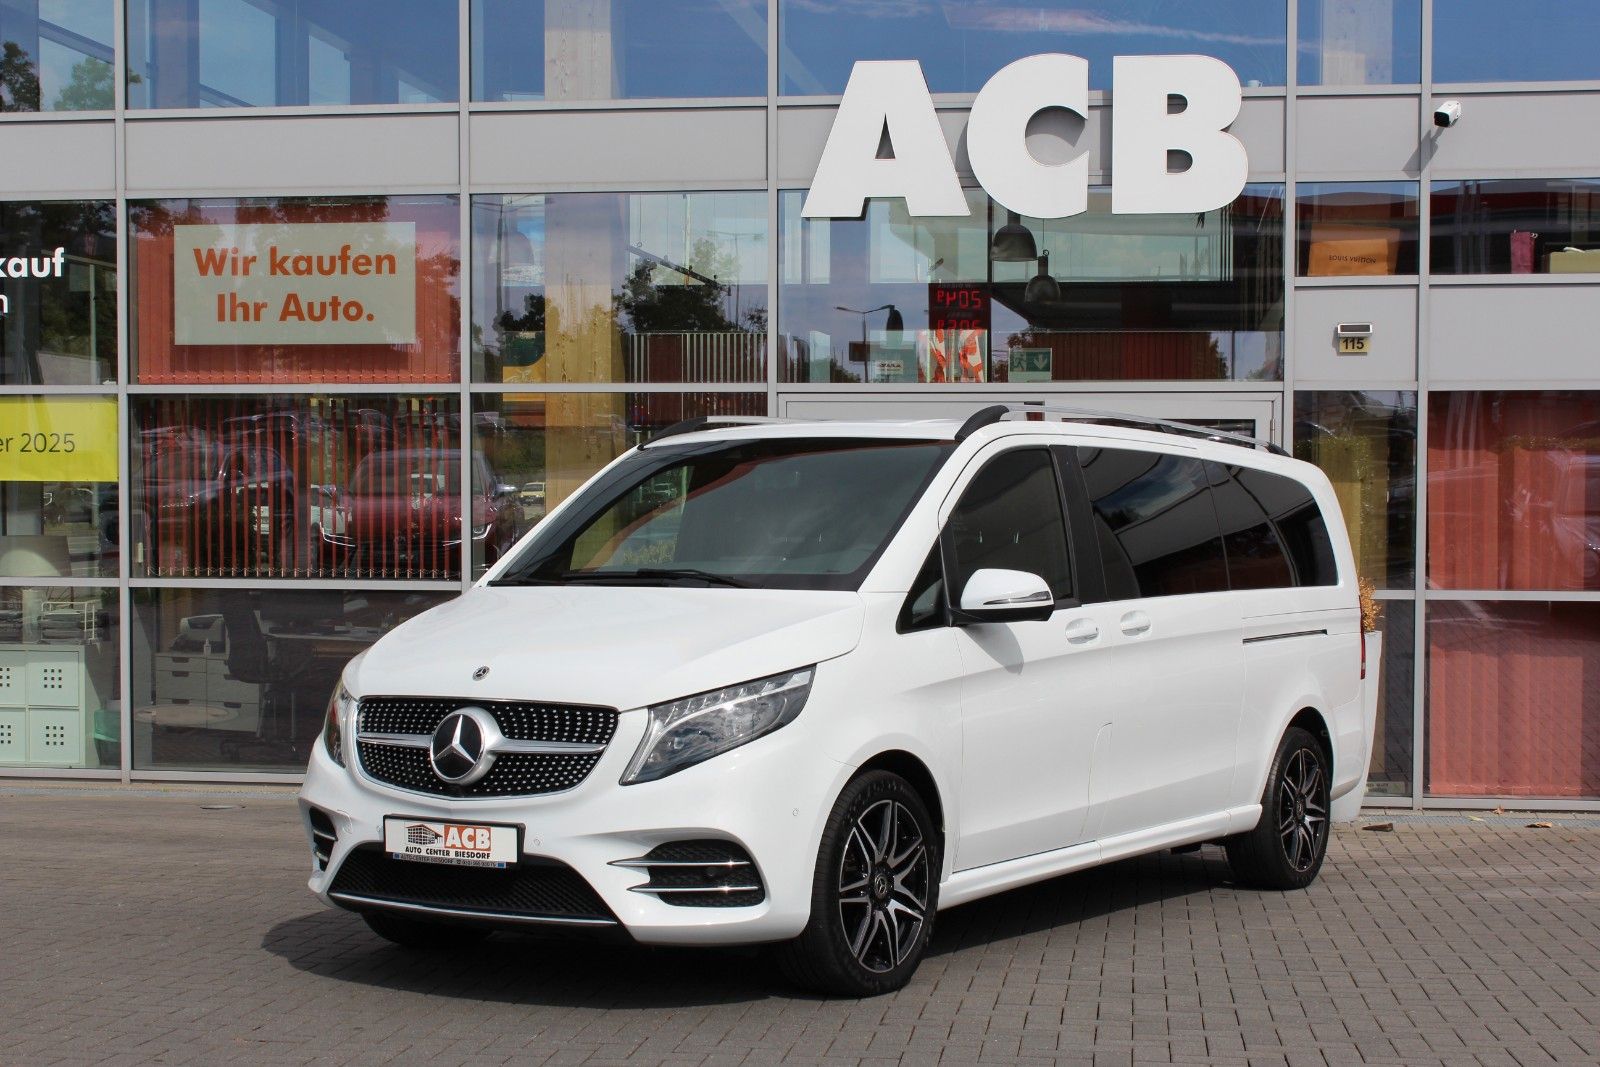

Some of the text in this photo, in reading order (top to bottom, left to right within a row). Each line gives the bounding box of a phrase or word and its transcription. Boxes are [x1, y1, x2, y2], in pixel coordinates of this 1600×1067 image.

[801, 53, 1248, 218] ACB
[193, 245, 397, 276] Wir kaufen
[217, 292, 375, 322] Ihr Auto.
[1342, 337, 1365, 350] 115
[20, 432, 76, 453] 2025
[445, 826, 491, 850] ACB
[405, 846, 491, 859] AUTO CENTER BIESDORF
